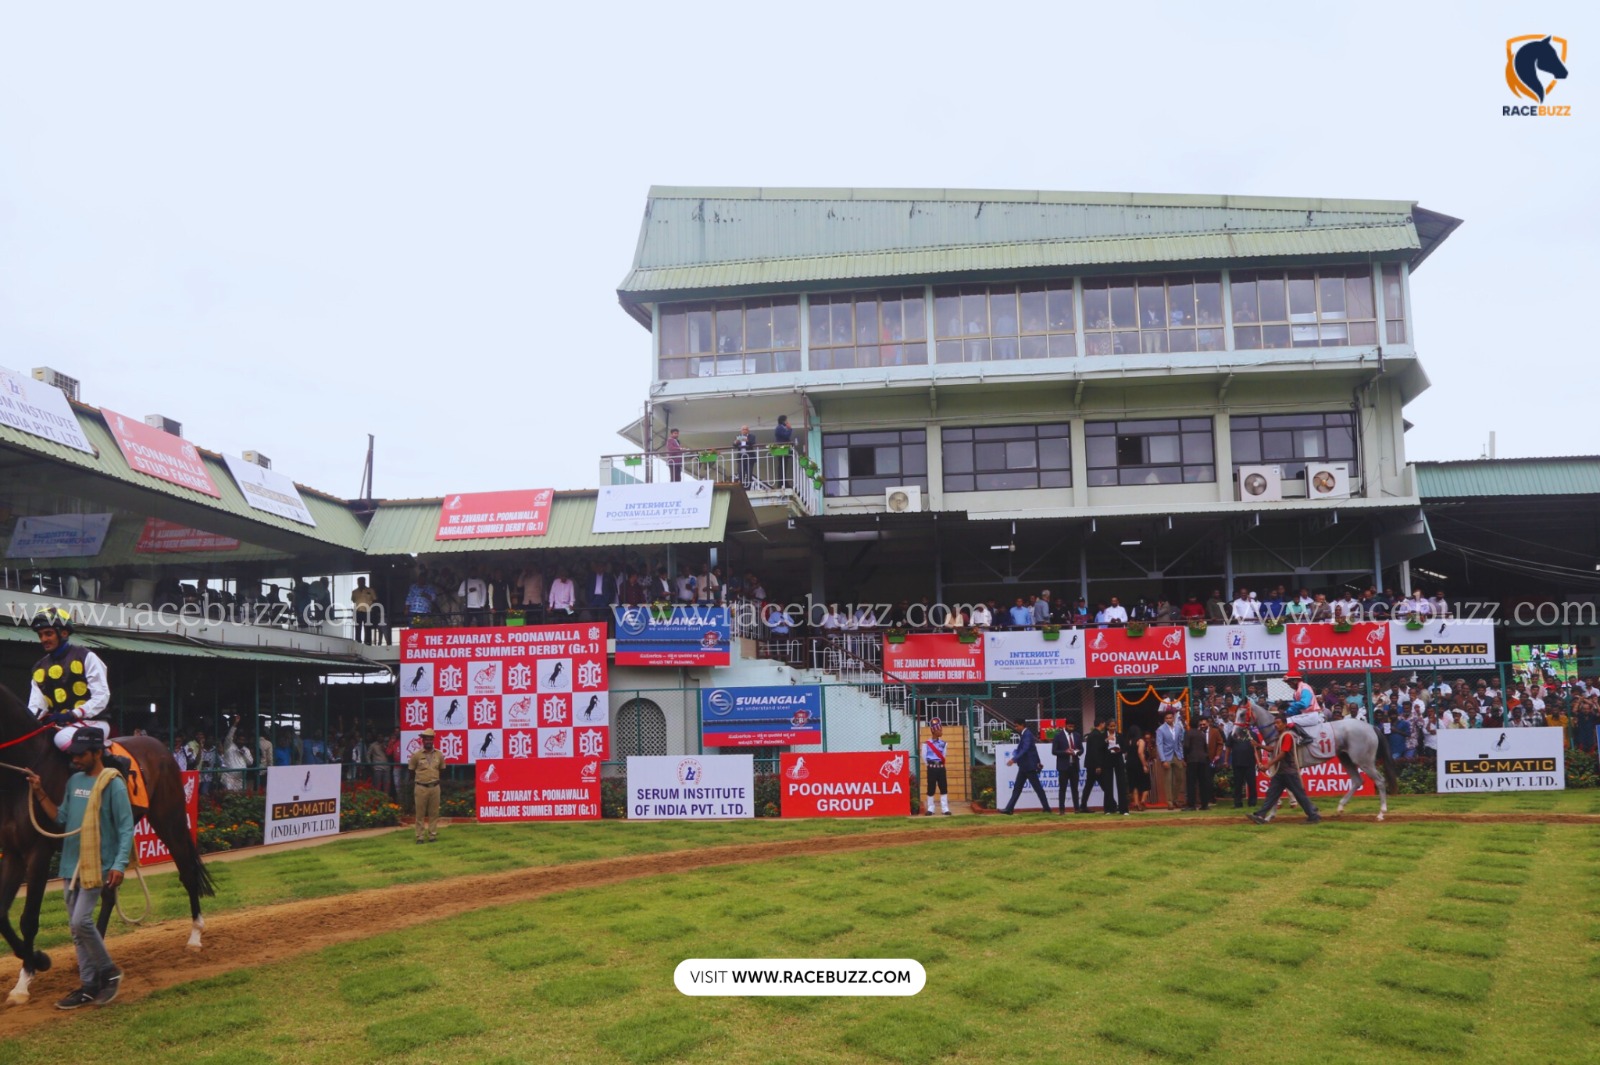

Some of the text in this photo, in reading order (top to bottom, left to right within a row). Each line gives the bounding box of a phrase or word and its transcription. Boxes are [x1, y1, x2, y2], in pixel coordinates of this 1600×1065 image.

[16, 400, 77, 432] INSTITUTE
[123, 438, 207, 479] POONAWALLA
[134, 456, 211, 492] STUD FARMS
[448, 514, 460, 524] THE
[496, 510, 539, 521] POONAWALLA
[606, 509, 660, 518] POONAWALLA
[439, 525, 476, 536] BANGALORE
[476, 523, 504, 534] SUMMER
[505, 522, 526, 532] DERBY
[648, 616, 717, 626] SUMANGALA
[424, 635, 442, 646] THE
[446, 633, 492, 645] ZAVARAY
[494, 632, 504, 644] S.
[508, 630, 580, 643] POONAWALLA
[406, 643, 599, 659] BANGALORE SUMMER DERBY (Gr.1)
[1091, 650, 1181, 662] POONAWALLA
[1194, 650, 1282, 662] SERUM INSTITUTE
[1294, 646, 1385, 658] POONAWALLA
[1400, 645, 1486, 654] EL-O-MATIC
[893, 659, 904, 668] THE
[937, 658, 976, 668] POONAWALLA
[994, 658, 1042, 666] POONAWALLA
[1208, 664, 1235, 672] INDIA
[1298, 658, 1382, 670] STUD FARMS
[920, 670, 946, 680] SUMMER
[946, 670, 965, 680] DERBY
[1114, 664, 1159, 674] GROUP
[736, 695, 806, 706] SUMANGALA
[1318, 738, 1332, 754] 11
[1450, 760, 1554, 772] EL-O-MATIC
[788, 782, 902, 796] POONAWALLA
[1445, 776, 1558, 790] (INDIA) PVT. LTD.
[488, 788, 589, 802] THE ZAVARAY S. POONAWALLA
[637, 788, 746, 800] SERUM INSTITUTE
[274, 800, 335, 819] EL-O-MATIC
[480, 804, 597, 818] BANGALORE SUMMER DERBY (Gr.1)
[635, 803, 748, 816] OF INDIA PVT. LTD.
[816, 798, 874, 812] GROUP
[271, 818, 336, 840] (INDIA) PVT. LTD.
